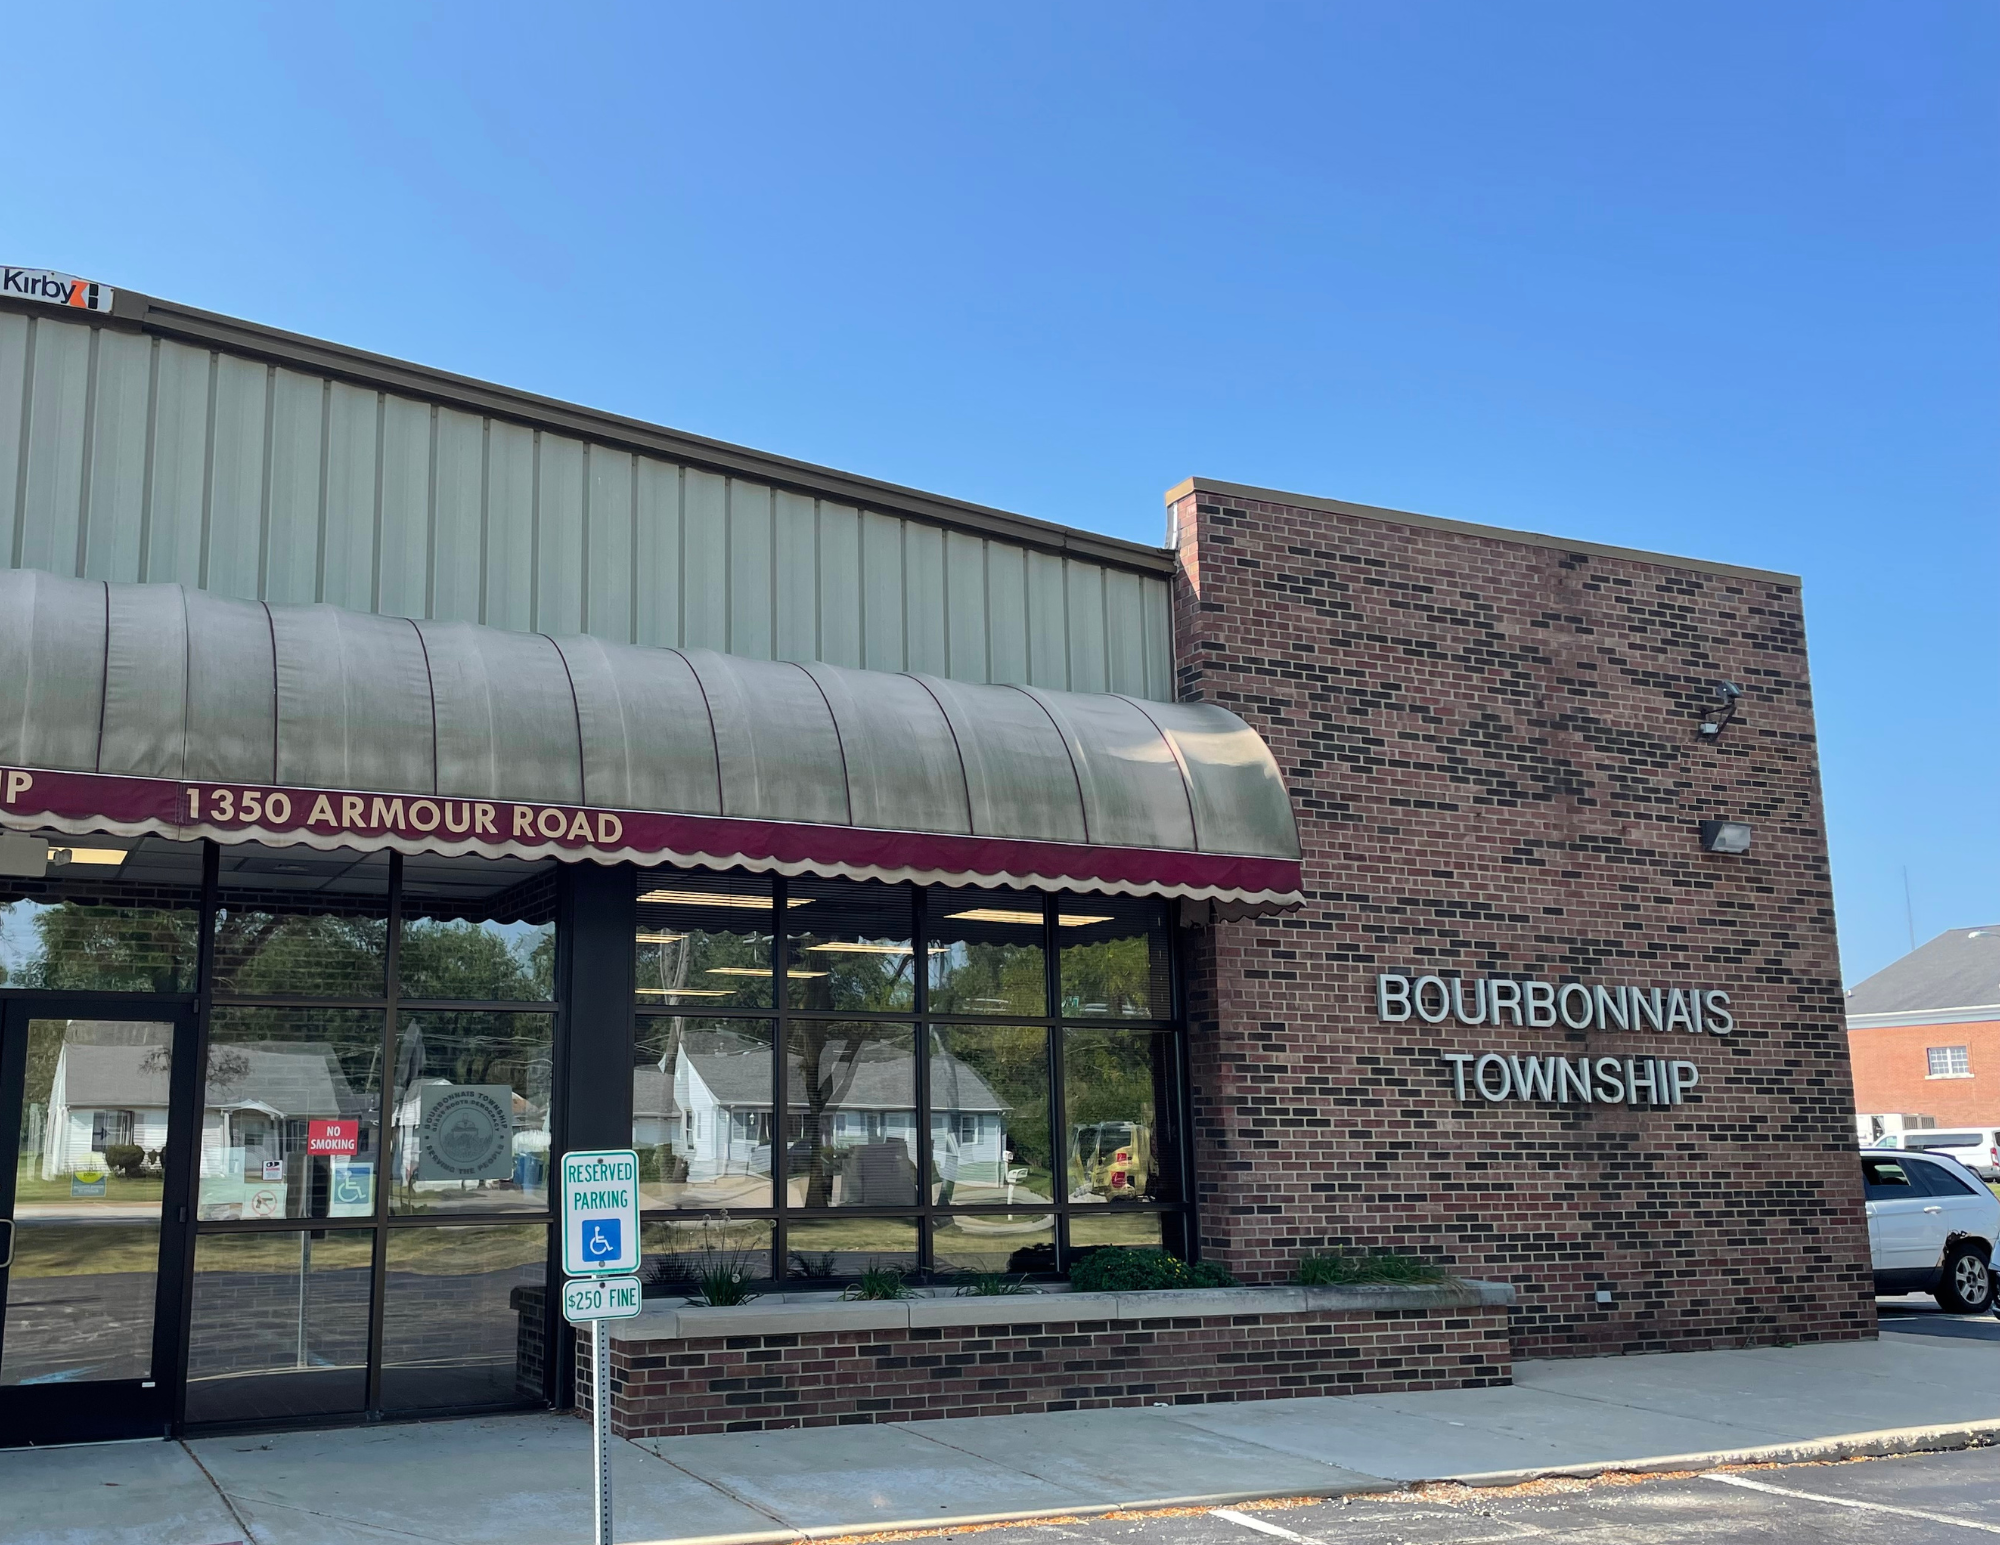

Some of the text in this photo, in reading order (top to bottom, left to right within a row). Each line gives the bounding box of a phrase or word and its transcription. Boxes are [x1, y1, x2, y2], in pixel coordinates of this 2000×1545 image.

[3, 268, 77, 304] Kirby
[0, 770, 33, 804] P
[186, 787, 623, 843] 1350 ARMOUR ROAD
[1376, 973, 1734, 1035] BOURBONNAIS
[1441, 1053, 1699, 1105] TOWNSHIP
[477, 1092, 508, 1129] TOWNSHIP
[310, 1139, 355, 1150] SMOKING
[326, 1126, 341, 1137] NO
[568, 1162, 632, 1183] RESERVED
[574, 1190, 628, 1211] PARKING
[568, 1287, 637, 1310] $250 FINE
